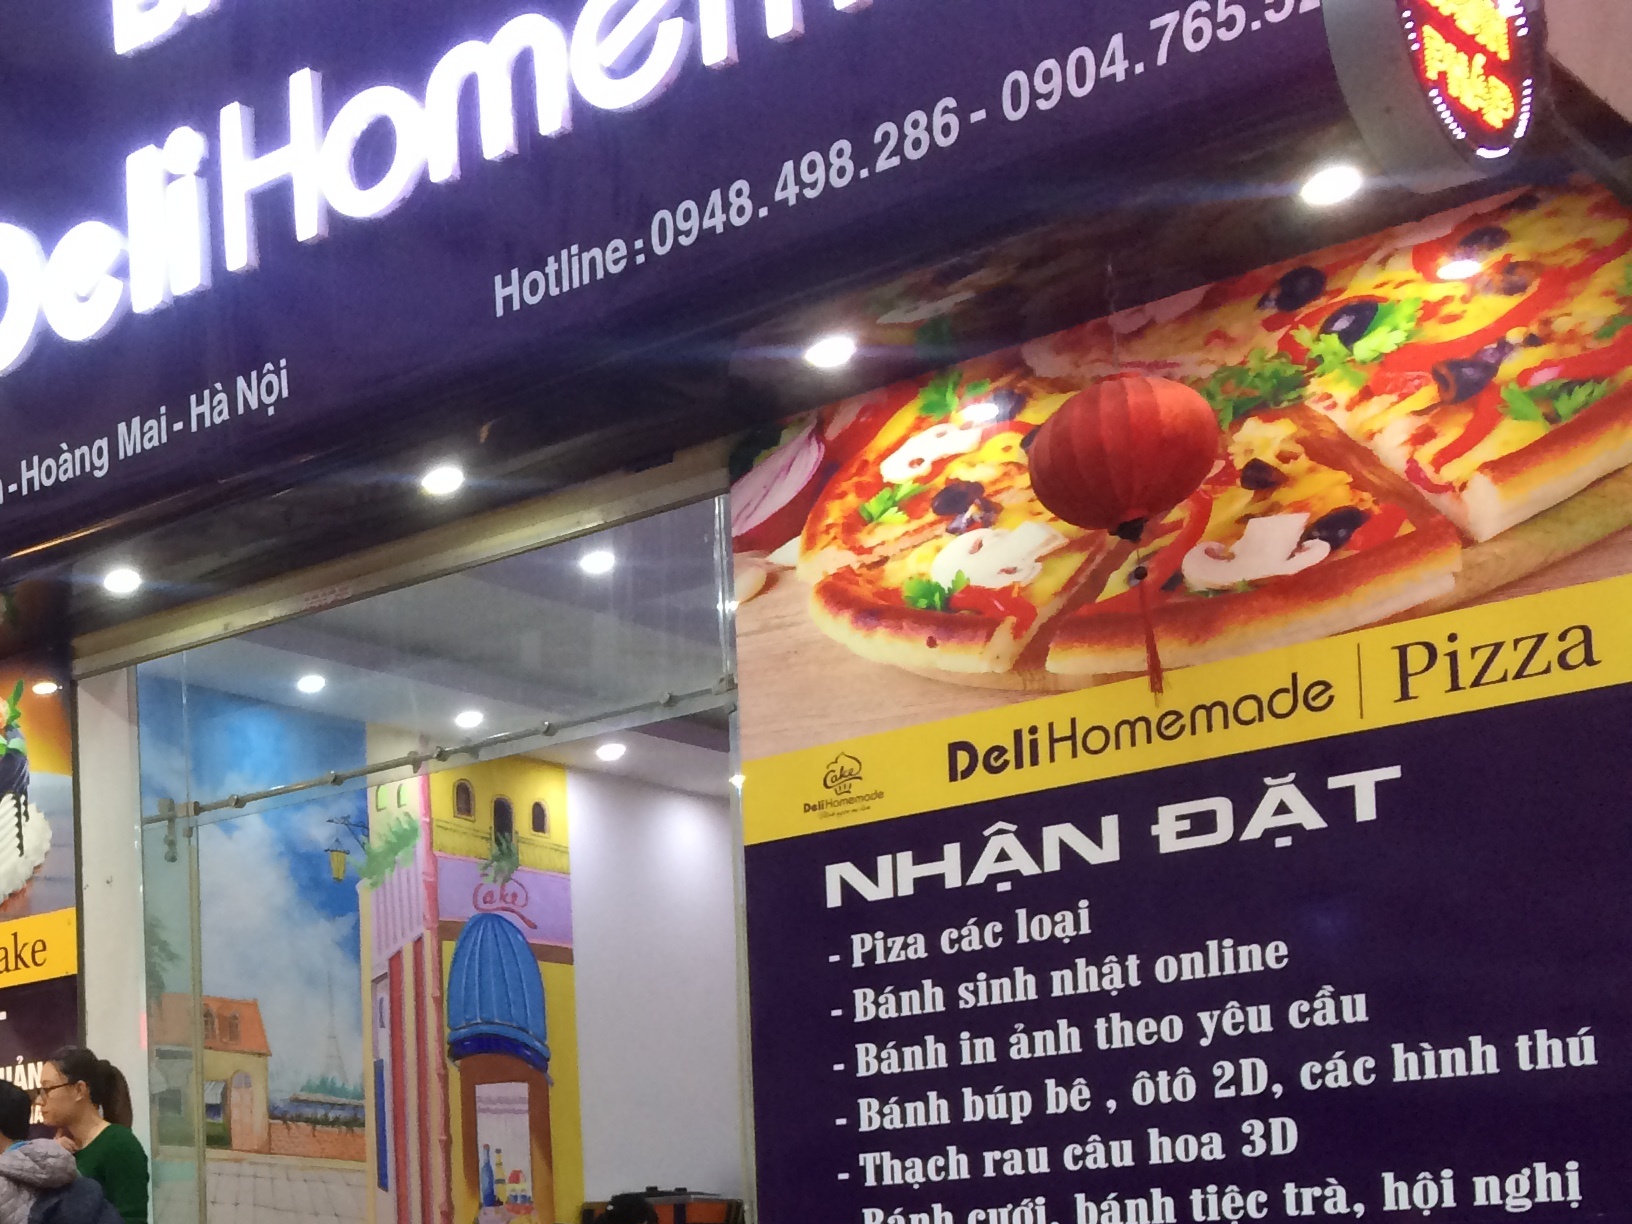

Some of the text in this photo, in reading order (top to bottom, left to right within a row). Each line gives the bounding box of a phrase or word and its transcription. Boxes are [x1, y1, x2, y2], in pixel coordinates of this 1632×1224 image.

[20, 441, 110, 496] Hoàng
[117, 405, 168, 461] Mai
[190, 382, 231, 433] Hà
[236, 358, 290, 416] Nội
[1391, 622, 1603, 704] Pizza
[825, 764, 1402, 908] NHẬN ĐẶT
[851, 899, 1092, 968] Piza các loại
[853, 938, 1290, 1023] Bánh sinh nhật online
[855, 984, 1369, 1077] Bánh in ảnh theo yêu cầu
[857, 1026, 1598, 1132] Bánh búp bê ôtô 2D, các hình thú
[859, 1116, 1299, 1189] Thạch rau câu hoa 3D
[1283, 1178, 1365, 1219] trà,
[1381, 1168, 1457, 1216] hội
[1473, 1160, 1582, 1214] nghị
